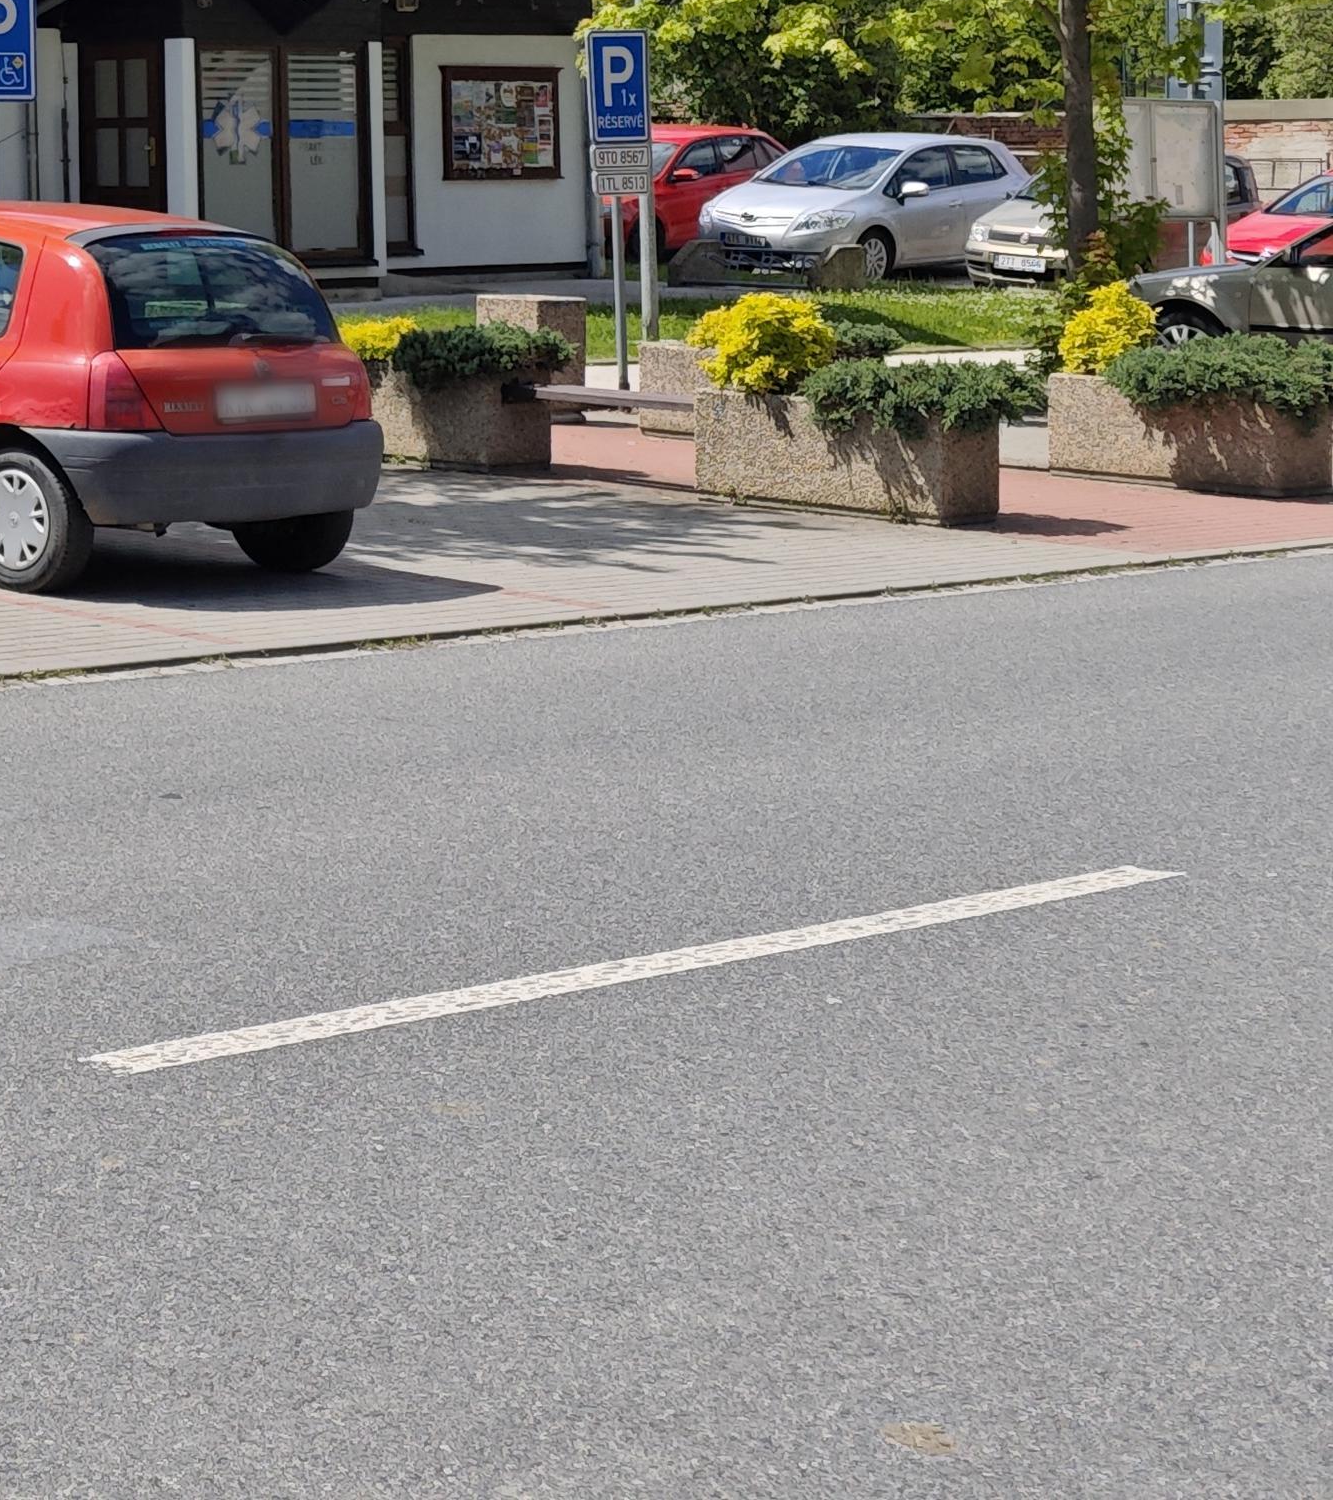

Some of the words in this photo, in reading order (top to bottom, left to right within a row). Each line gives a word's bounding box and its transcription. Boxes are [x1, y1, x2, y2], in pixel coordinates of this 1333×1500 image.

[602, 46, 634, 107] P
[621, 89, 637, 107] 1x
[598, 112, 644, 129] RÉSERVÉ
[620, 150, 645, 164] 8567
[622, 176, 645, 190] 8513
